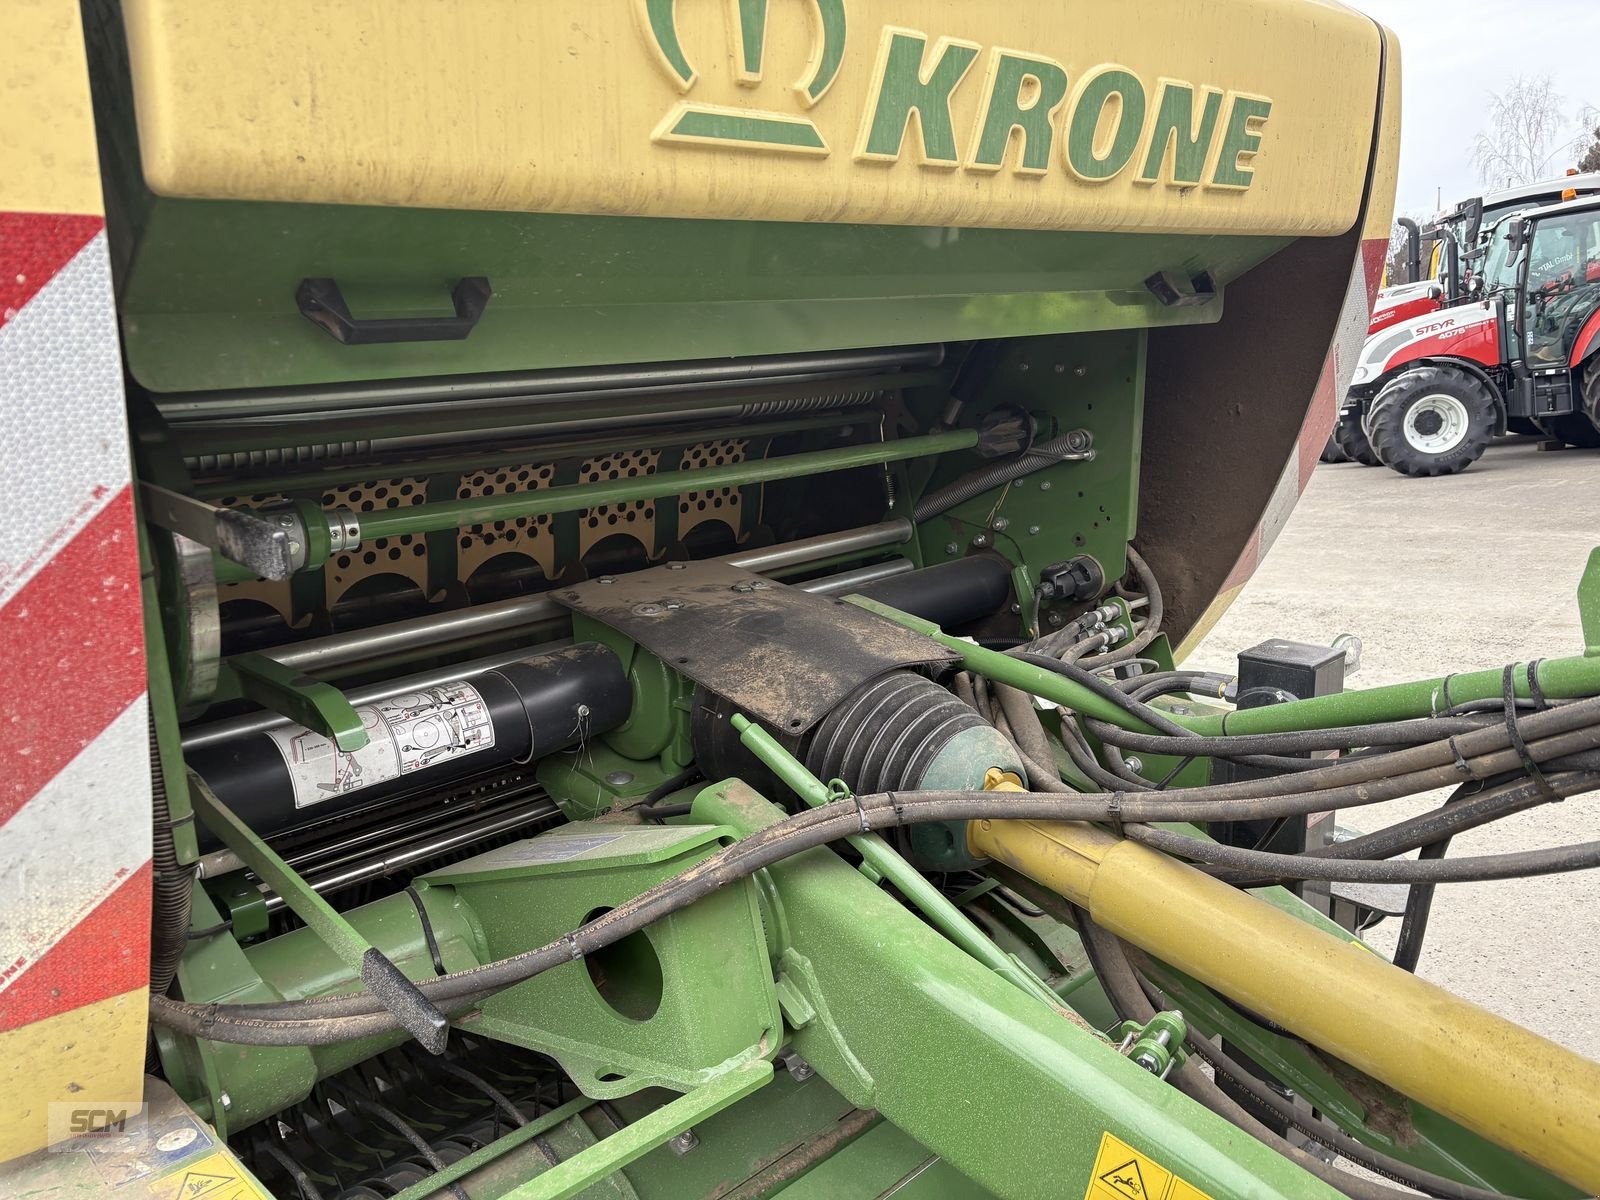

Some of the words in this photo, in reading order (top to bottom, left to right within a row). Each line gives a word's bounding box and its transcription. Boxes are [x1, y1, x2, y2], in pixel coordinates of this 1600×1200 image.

[855, 25, 1272, 191] KRONE
[1415, 318, 1455, 336] STEYR
[1438, 327, 1466, 341] 4075
[1322, 1140, 1365, 1167] MUELLER
[1365, 1162, 1418, 1190] HYDRAULIK
